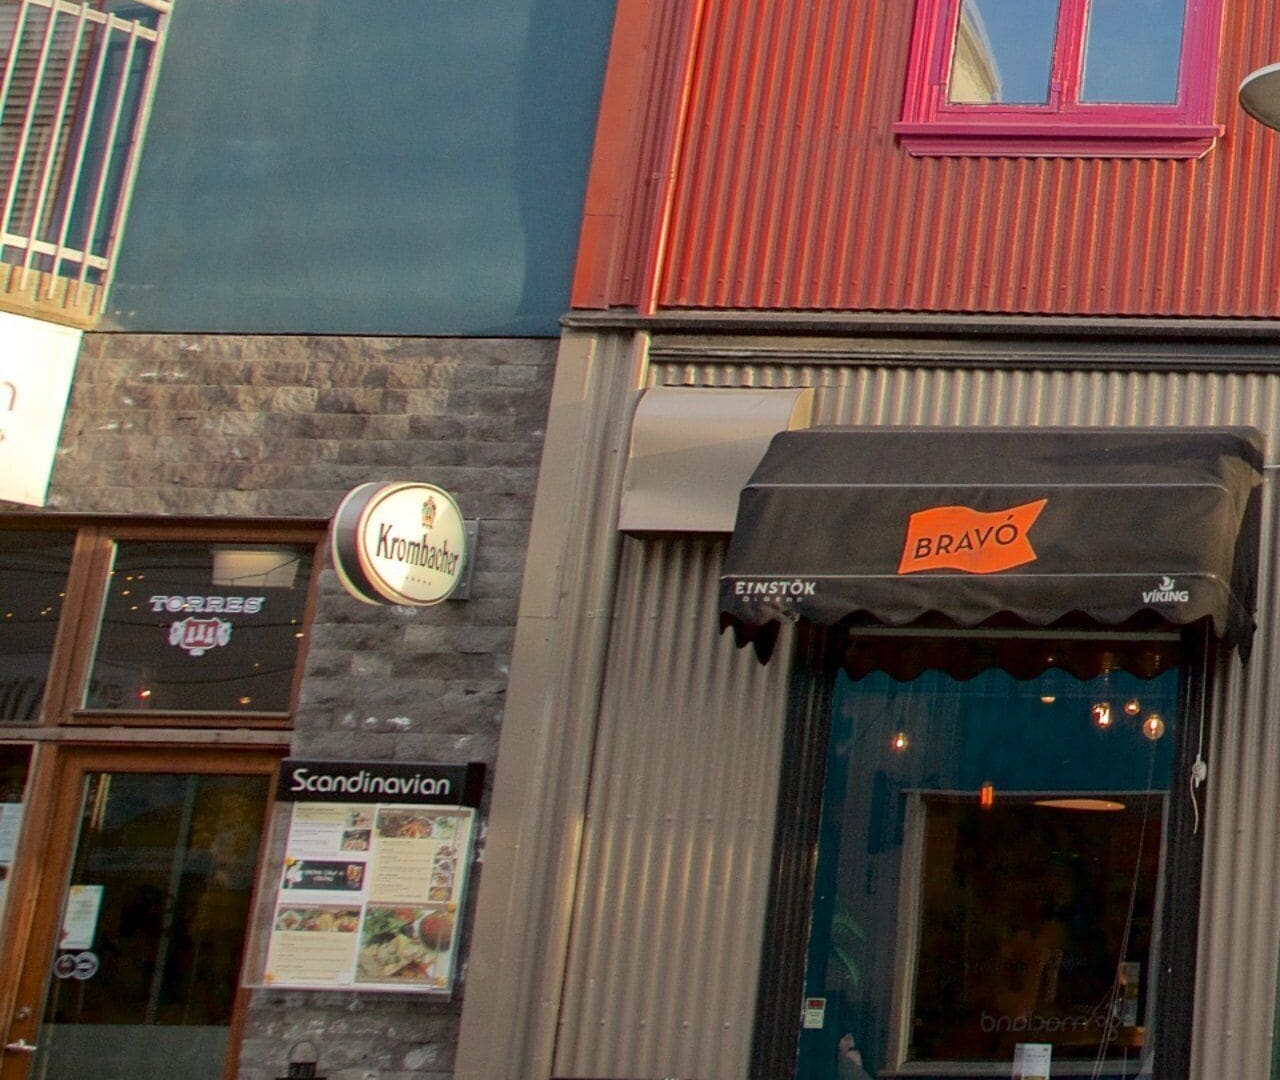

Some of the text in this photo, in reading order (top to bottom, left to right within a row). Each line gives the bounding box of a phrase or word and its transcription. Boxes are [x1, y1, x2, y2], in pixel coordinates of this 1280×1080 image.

[376, 523, 459, 576] Krombacher
[914, 515, 1018, 559] BRAVÓ
[735, 579, 816, 595] EINSTÖK
[149, 596, 265, 613] TORRES
[291, 769, 450, 795] Scandinavian
